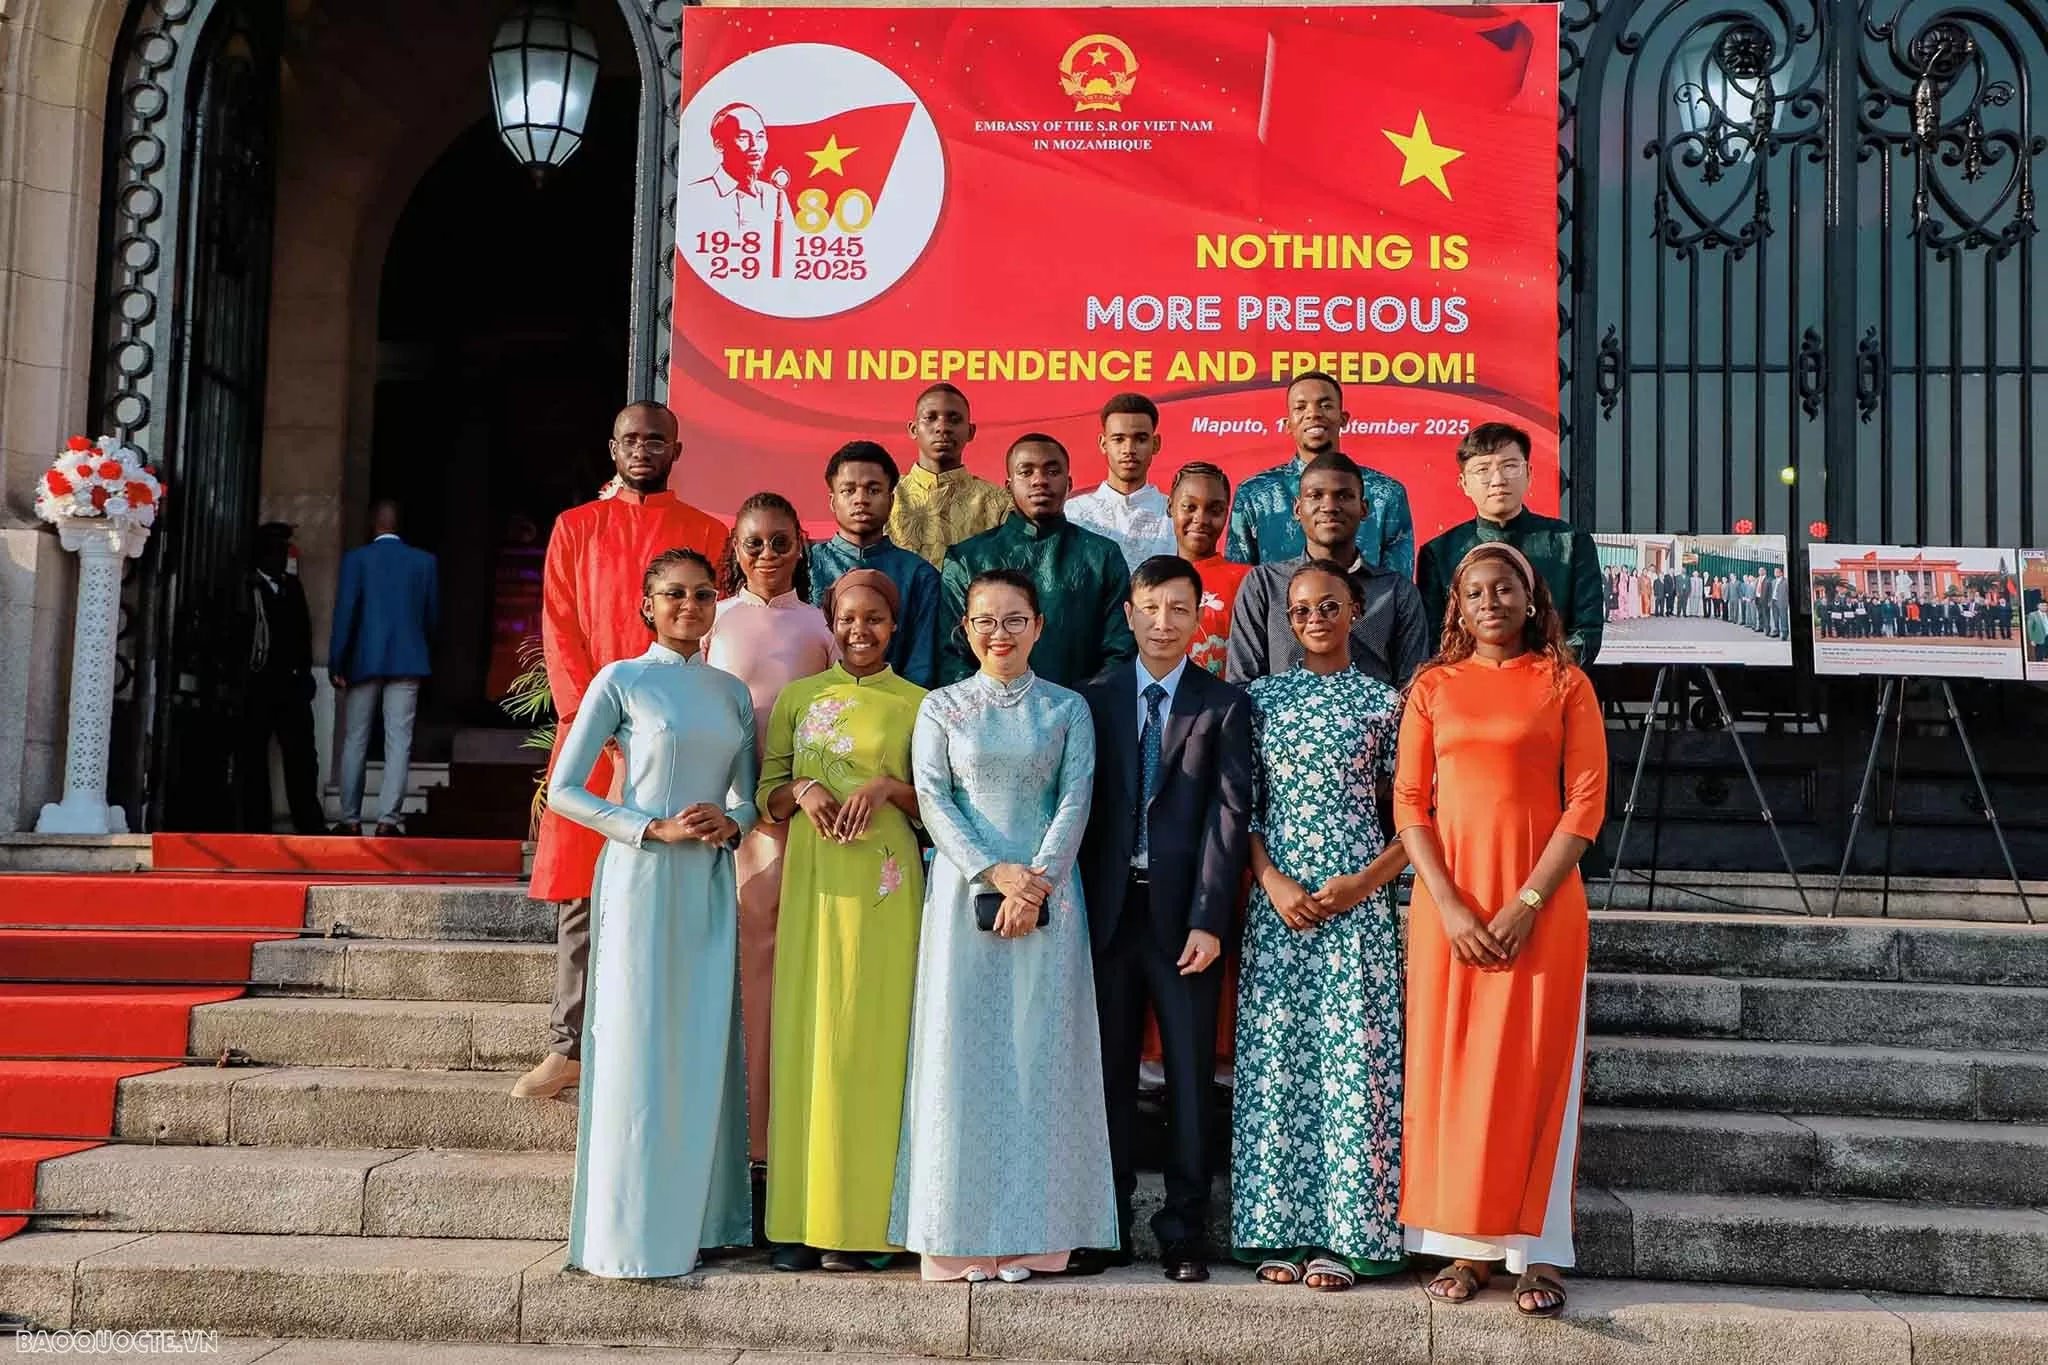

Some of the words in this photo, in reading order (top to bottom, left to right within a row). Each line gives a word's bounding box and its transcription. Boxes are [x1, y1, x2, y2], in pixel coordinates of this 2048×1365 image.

[975, 121, 1040, 132] EMBASSY
[1043, 121, 1063, 132] OF
[1065, 121, 1094, 132] THE
[1096, 121, 1118, 132] S.R
[1121, 121, 1141, 132] OF
[1143, 121, 1177, 132] VIET
[1180, 121, 1213, 132] NAM
[1034, 139, 1049, 150] IN
[1053, 139, 1153, 152] MOZAMBIQUE
[795, 188, 873, 234] 80
[695, 231, 761, 254] 19-8
[795, 236, 864, 257] 1945
[1196, 233, 1414, 270] NOTHING
[1429, 234, 1470, 270] IS
[710, 257, 760, 280] 2-9
[794, 259, 868, 280] 2025
[1085, 295, 1222, 332] MORE
[1237, 295, 1470, 332] PRECIOUS
[724, 349, 832, 380] THAN
[847, 350, 1152, 382] INDEPENDENCE
[1166, 350, 1257, 382] AND
[1271, 351, 1476, 384] FREEDOM!
[1191, 417, 1268, 436] Maputo,
[1339, 418, 1419, 438] ptember
[1424, 420, 1470, 435] 2025
